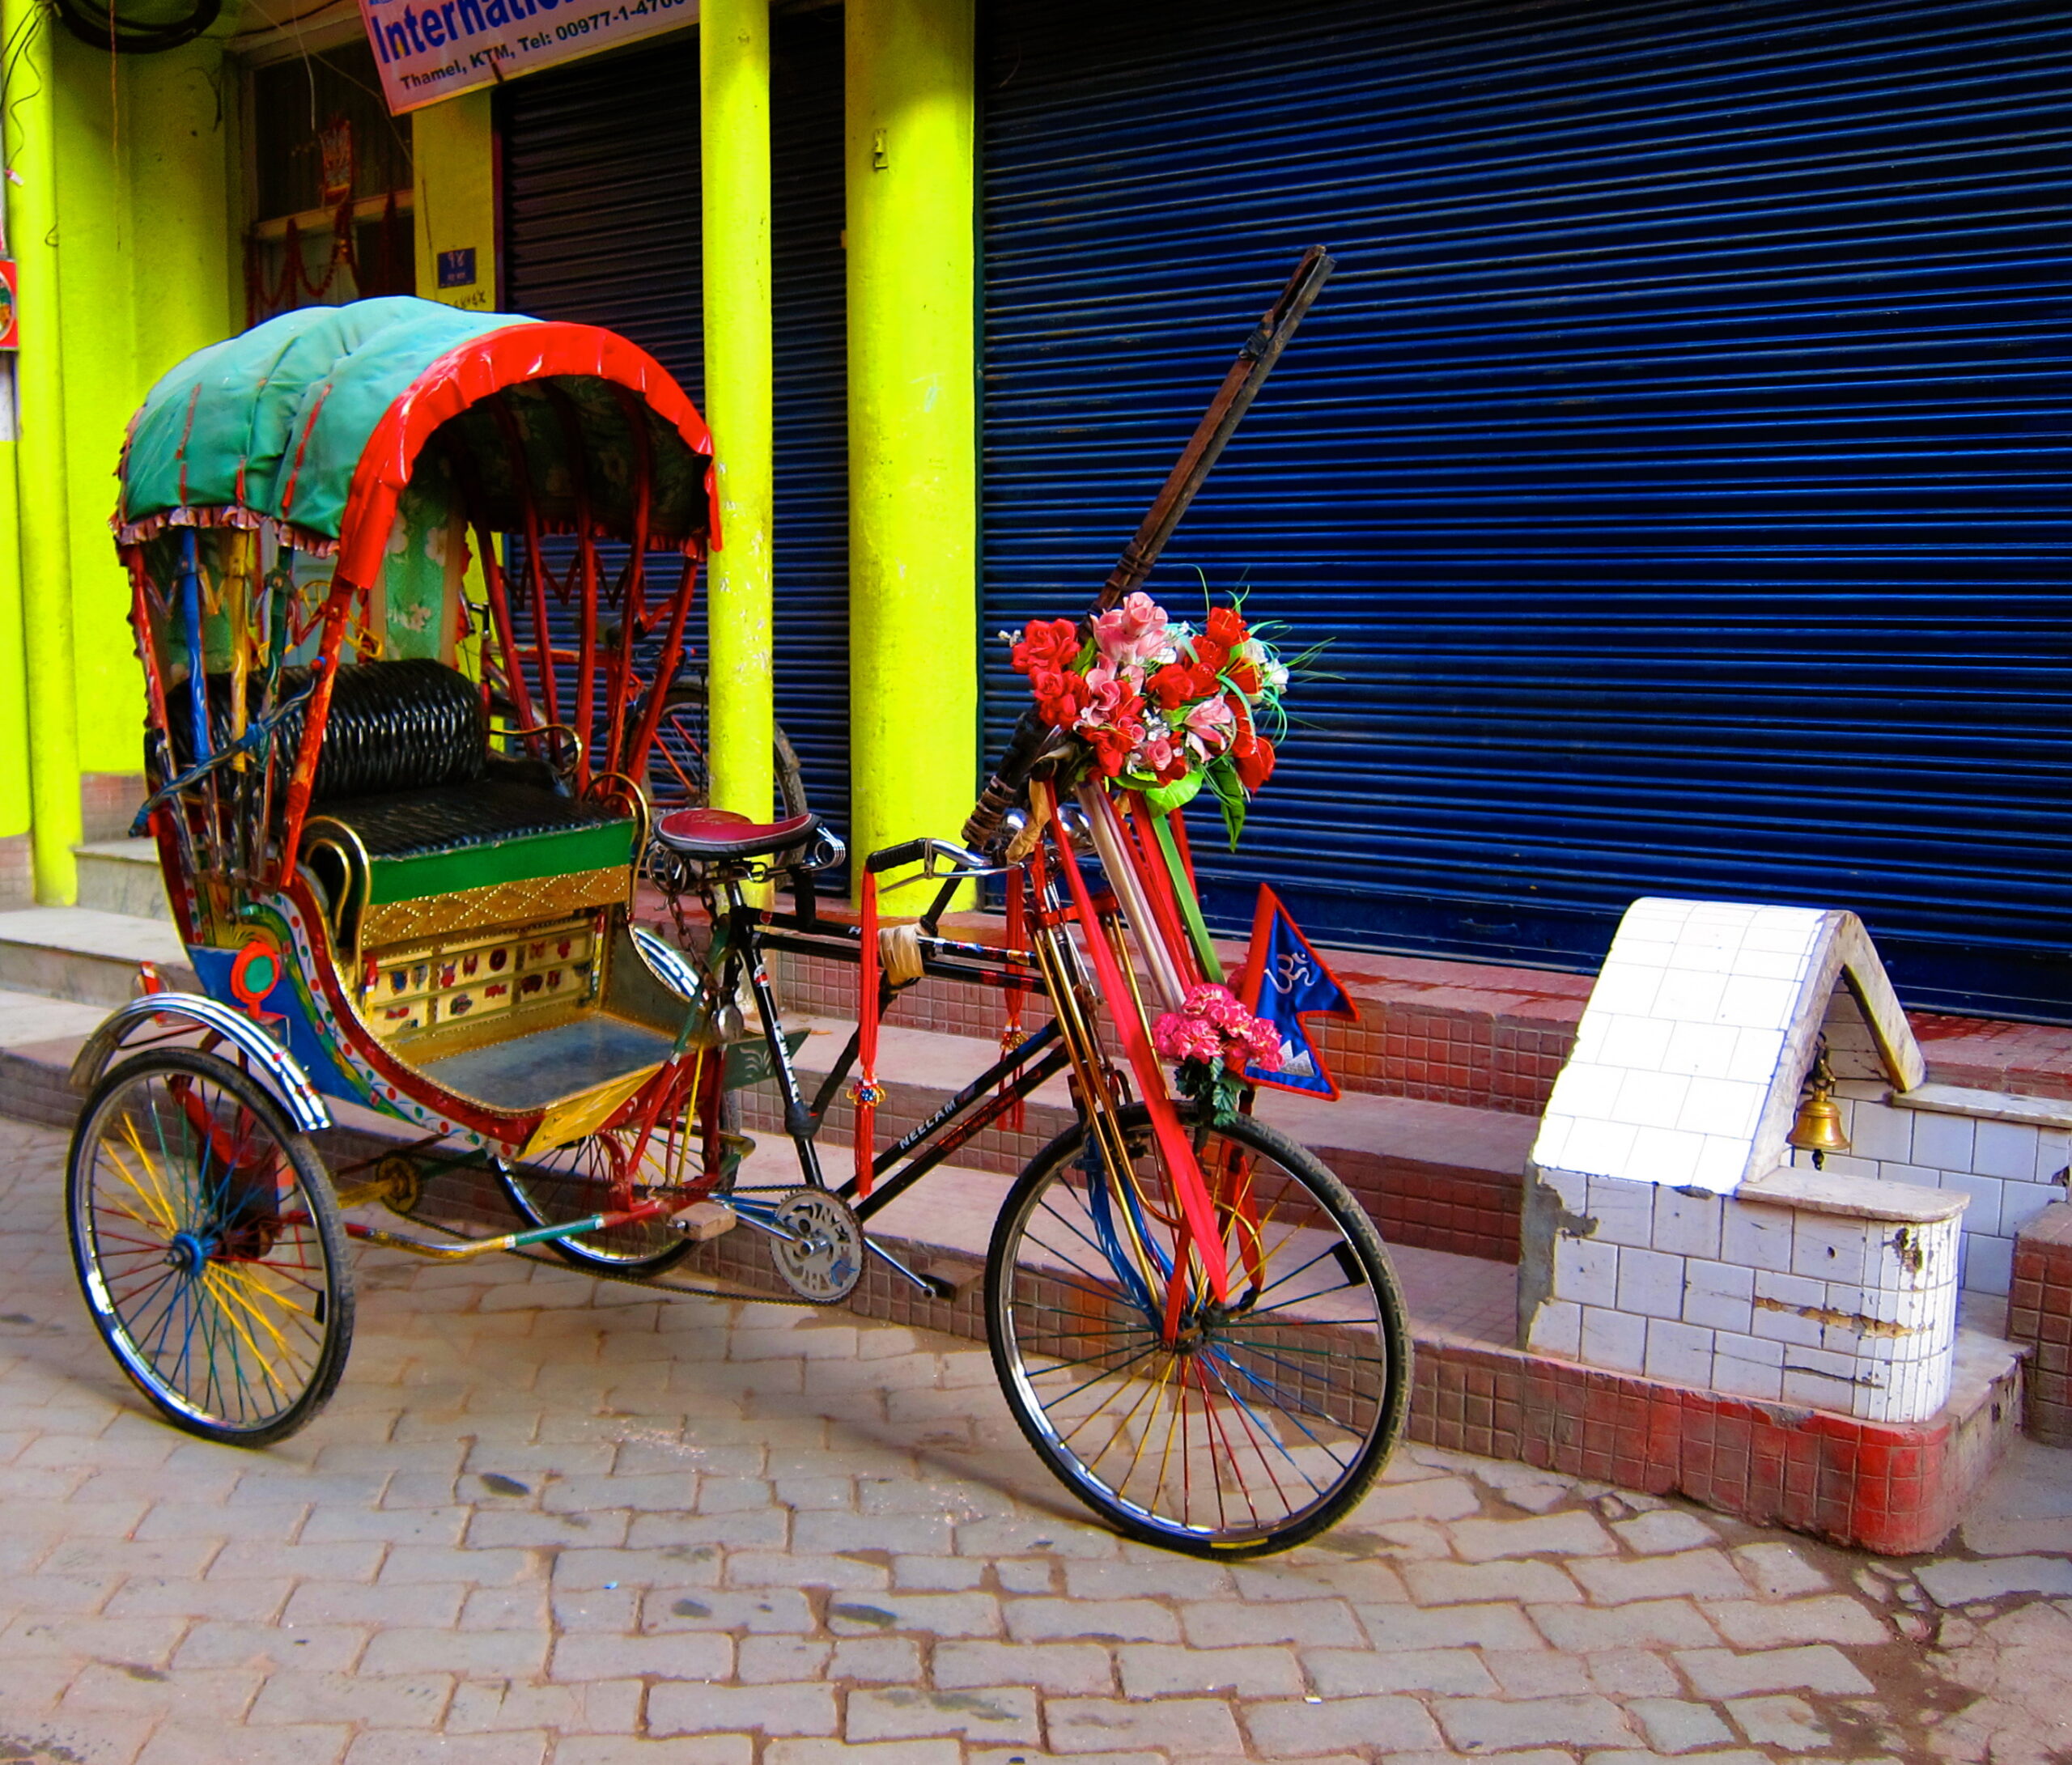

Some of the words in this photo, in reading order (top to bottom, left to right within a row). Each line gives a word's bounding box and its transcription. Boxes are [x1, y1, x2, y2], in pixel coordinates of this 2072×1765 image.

[371, 0, 574, 64] Interna
[399, 60, 467, 90] Thamel,
[469, 44, 516, 69] KTM,
[517, 32, 552, 52] Tel:
[555, 0, 685, 40] 00977-1-470
[898, 1099, 957, 1150] NEELAM
